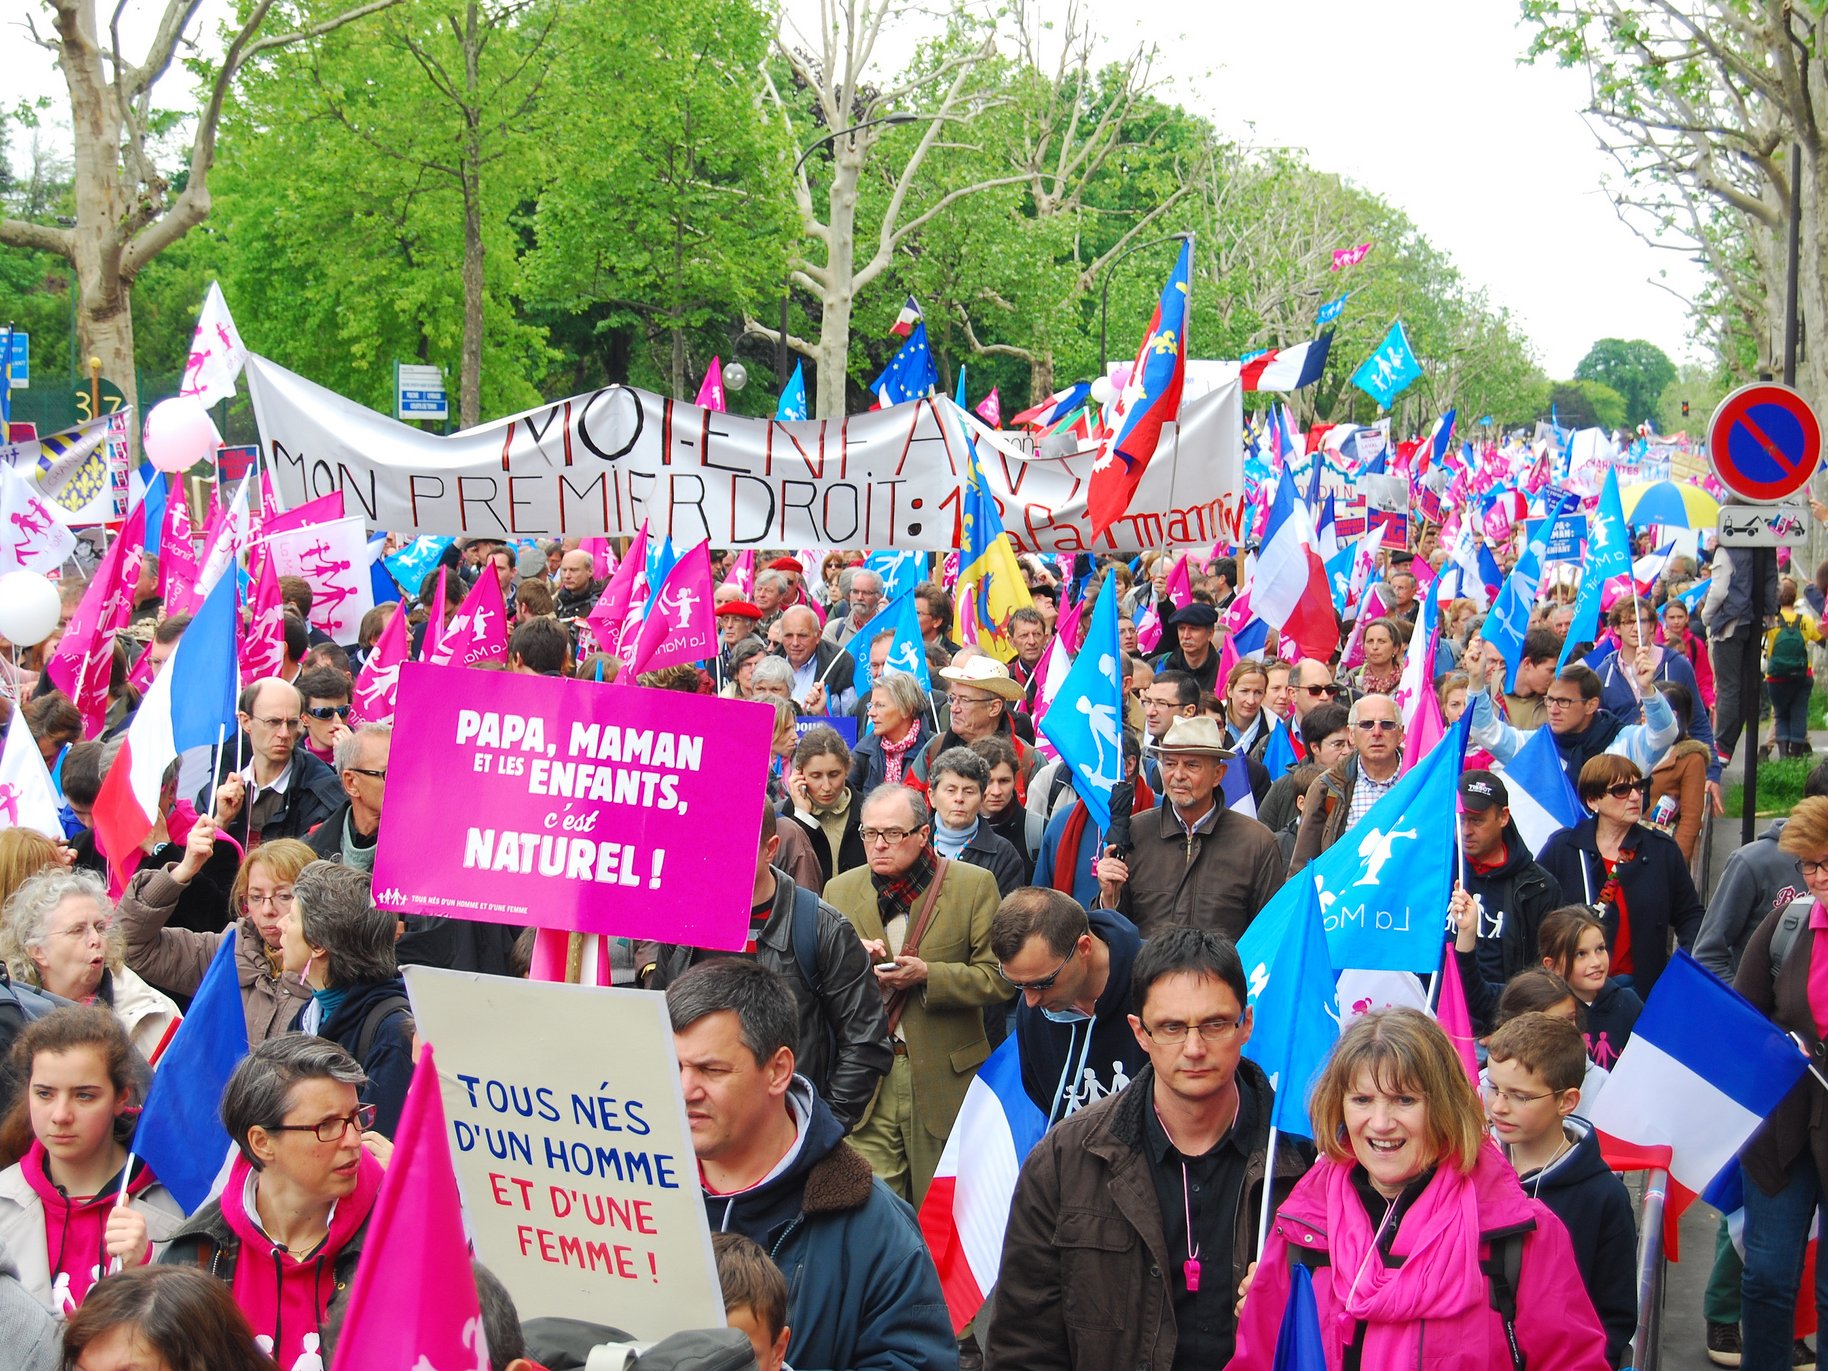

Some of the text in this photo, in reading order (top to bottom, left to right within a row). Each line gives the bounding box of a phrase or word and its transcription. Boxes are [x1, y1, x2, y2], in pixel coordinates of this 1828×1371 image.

[272, 439, 378, 522] MON
[455, 709, 704, 772] PAPA, MAMAN
[473, 752, 689, 816] ET LES ENFANTS,
[462, 827, 666, 889] NATUREL !
[411, 894, 427, 903] TOUS
[428, 895, 440, 905] NÉS
[441, 897, 456, 907] D'UN
[456, 900, 479, 910] HOMME
[488, 903, 506, 912] D'UNE
[507, 905, 528, 914] FEMME
[457, 1073, 651, 1136] TOUS NÉS
[453, 1119, 680, 1189] D'UN HOMME
[488, 1172, 658, 1235] ET D'UNE
[517, 1225, 639, 1279] FEMME
